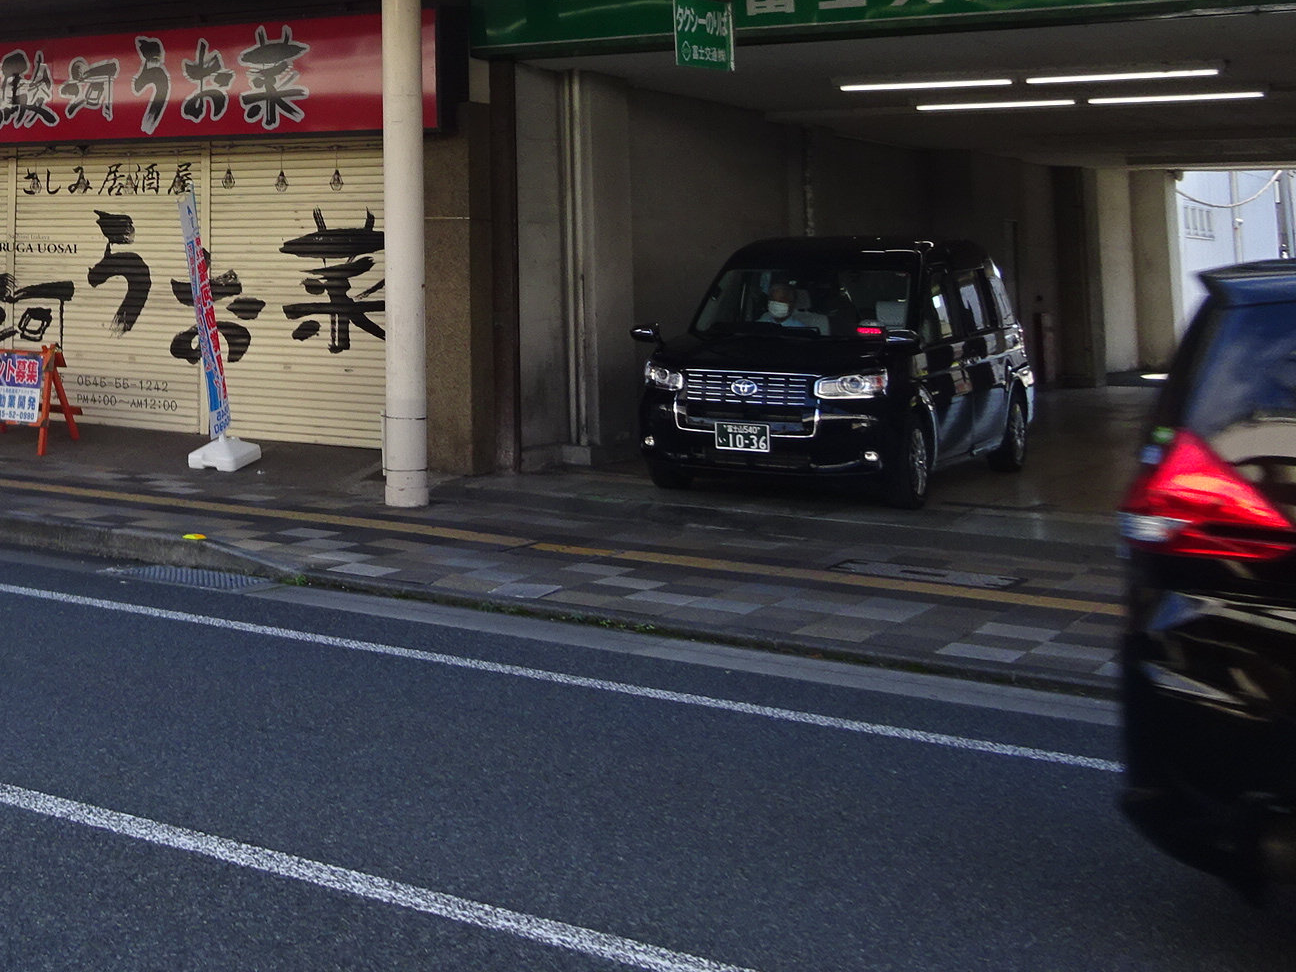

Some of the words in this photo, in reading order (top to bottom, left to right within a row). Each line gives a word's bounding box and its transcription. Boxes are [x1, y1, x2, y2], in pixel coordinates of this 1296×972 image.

[676, 4, 728, 37] タクシーのりば
[22, 162, 193, 196] さしみ居酒屋
[37, 242, 78, 254] UOSAI
[76, 375, 169, 393] 0545-55-1242
[729, 433, 767, 450] 10-36
